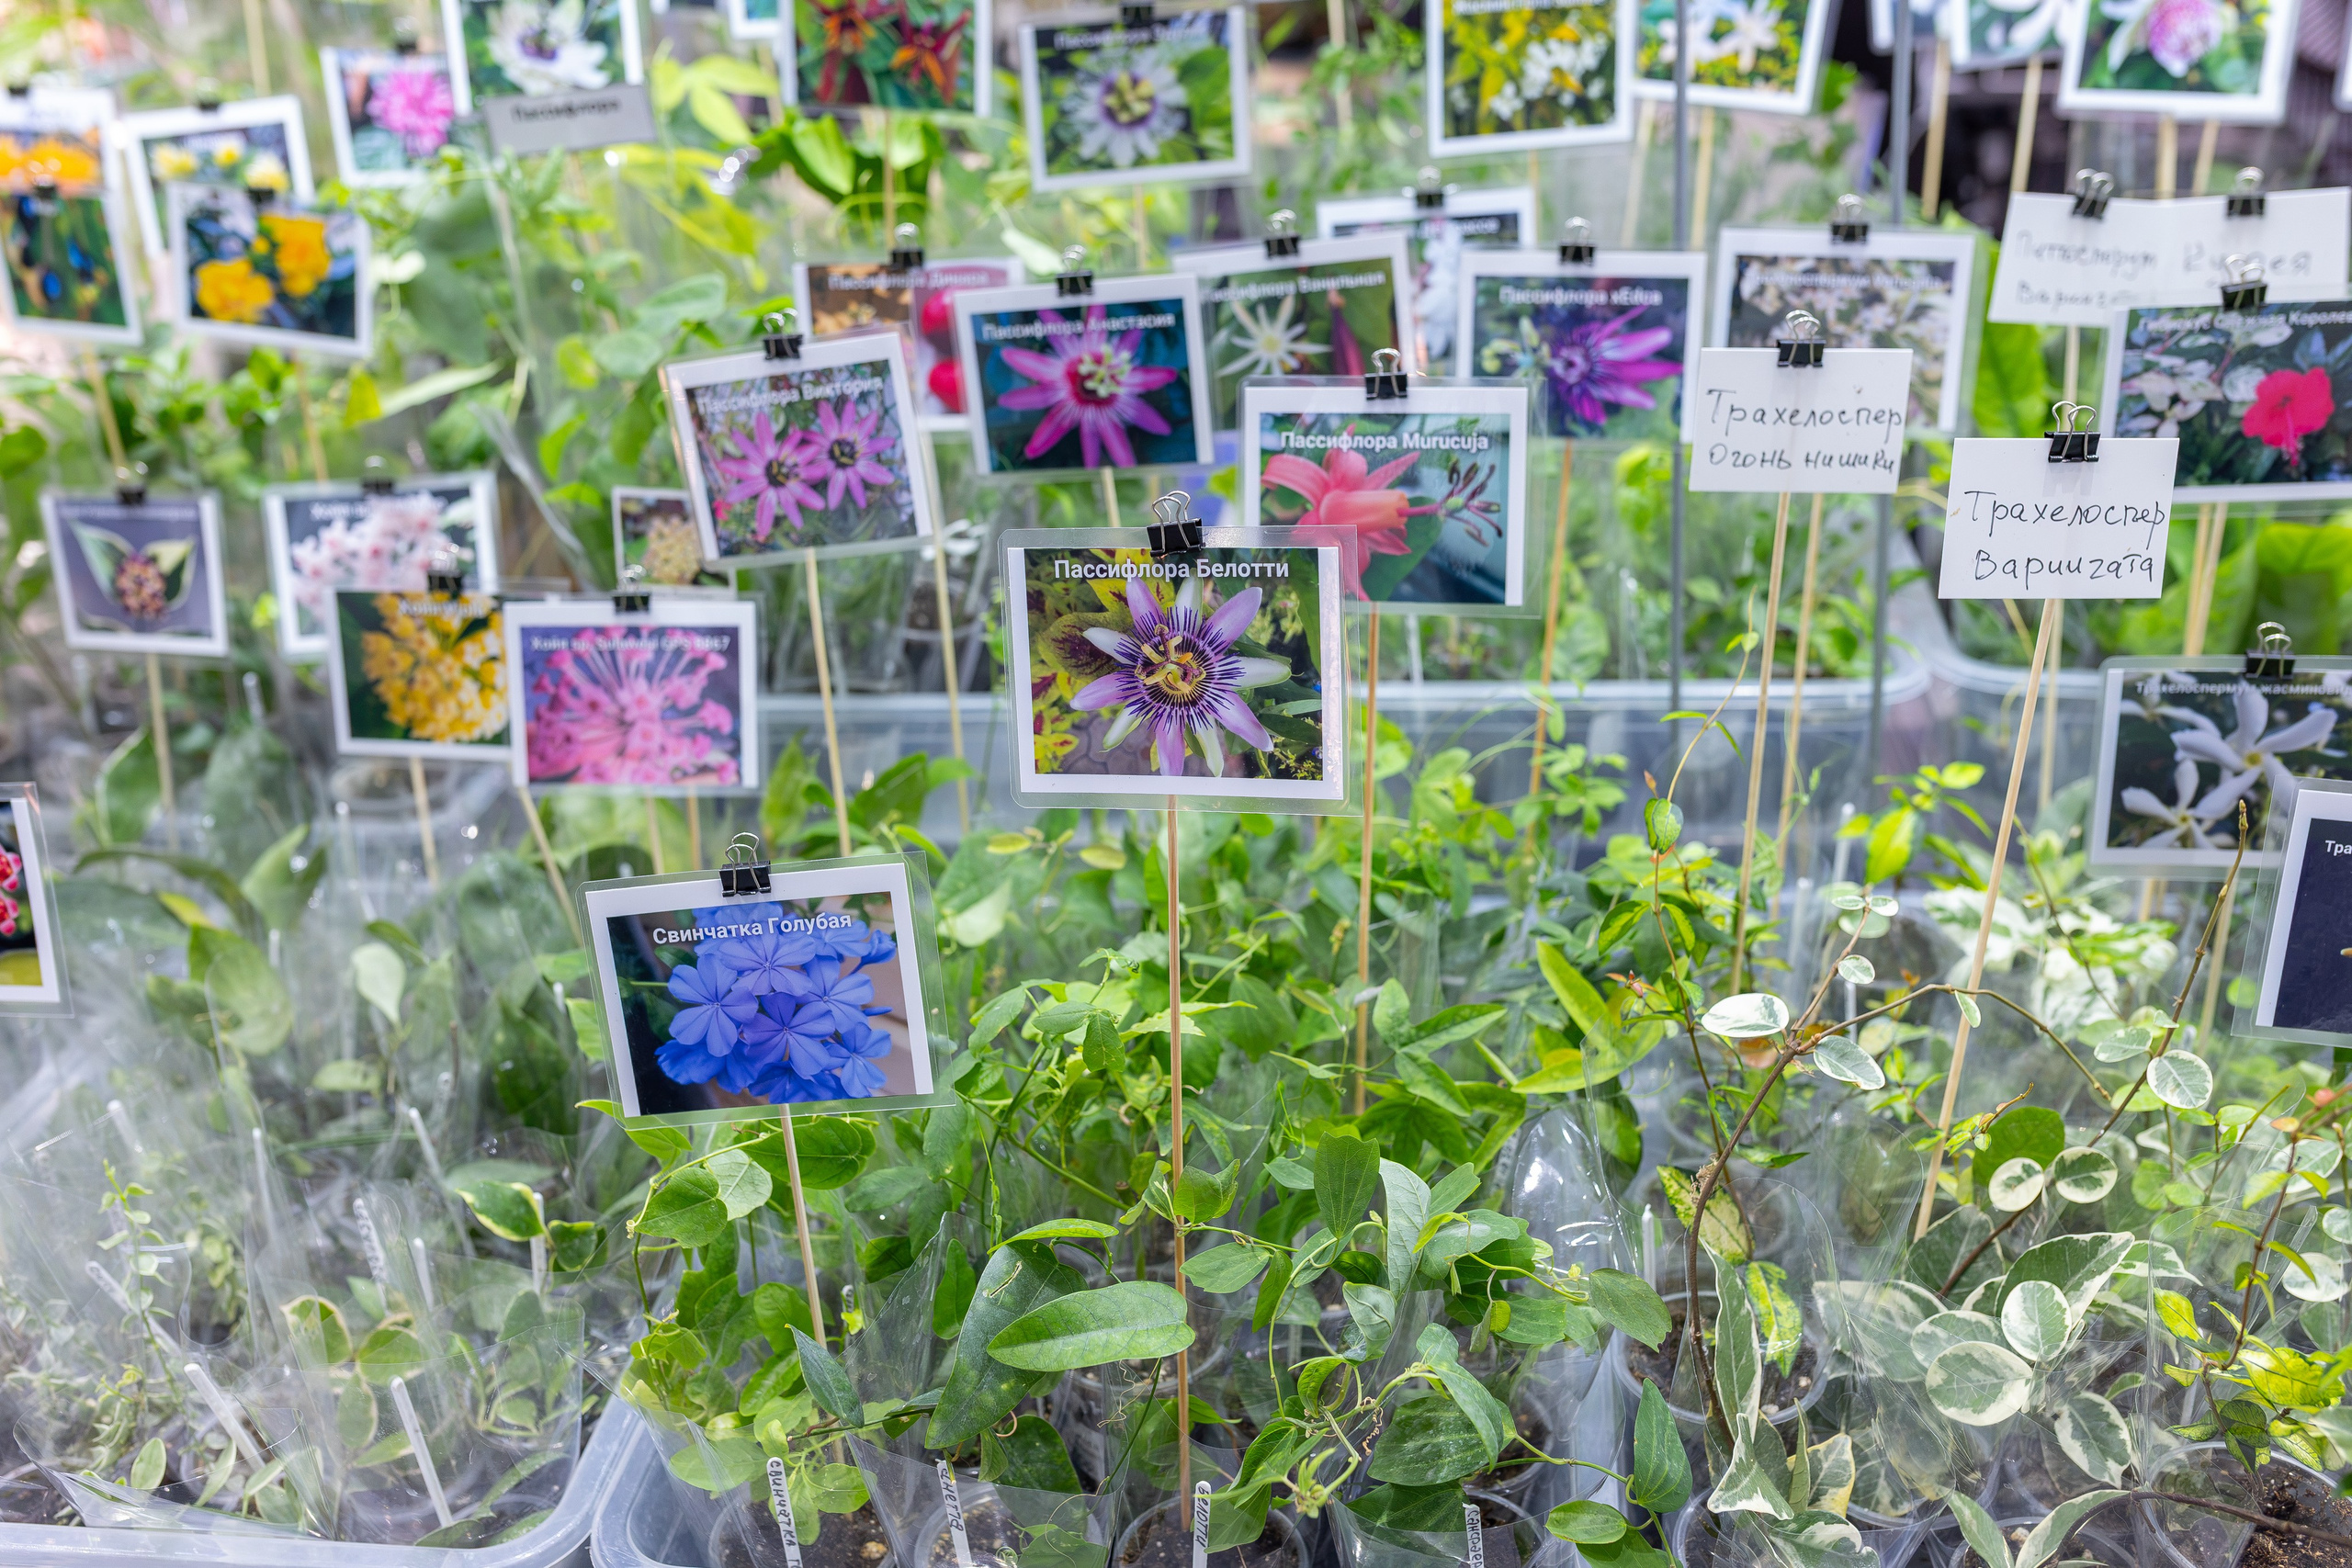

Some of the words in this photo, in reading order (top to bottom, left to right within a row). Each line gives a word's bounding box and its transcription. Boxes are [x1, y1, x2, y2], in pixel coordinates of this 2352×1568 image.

[1499, 285, 1608, 308] Пассифлора
[982, 320, 1084, 340] Пассифлора
[1706, 388, 1903, 445] Трахелоспер
[1280, 431, 1398, 453] Пассифлора
[1402, 432, 1489, 454] Murucuja
[1709, 442, 1792, 470] Огонь
[1963, 490, 2165, 551] Трахелоспер
[1054, 558, 1190, 582] Пассифлора
[1196, 558, 1290, 579] Белотти
[2324, 840, 2352, 857] Тра
[652, 919, 763, 945] Свинчатка
[768, 912, 853, 937] Голубая
